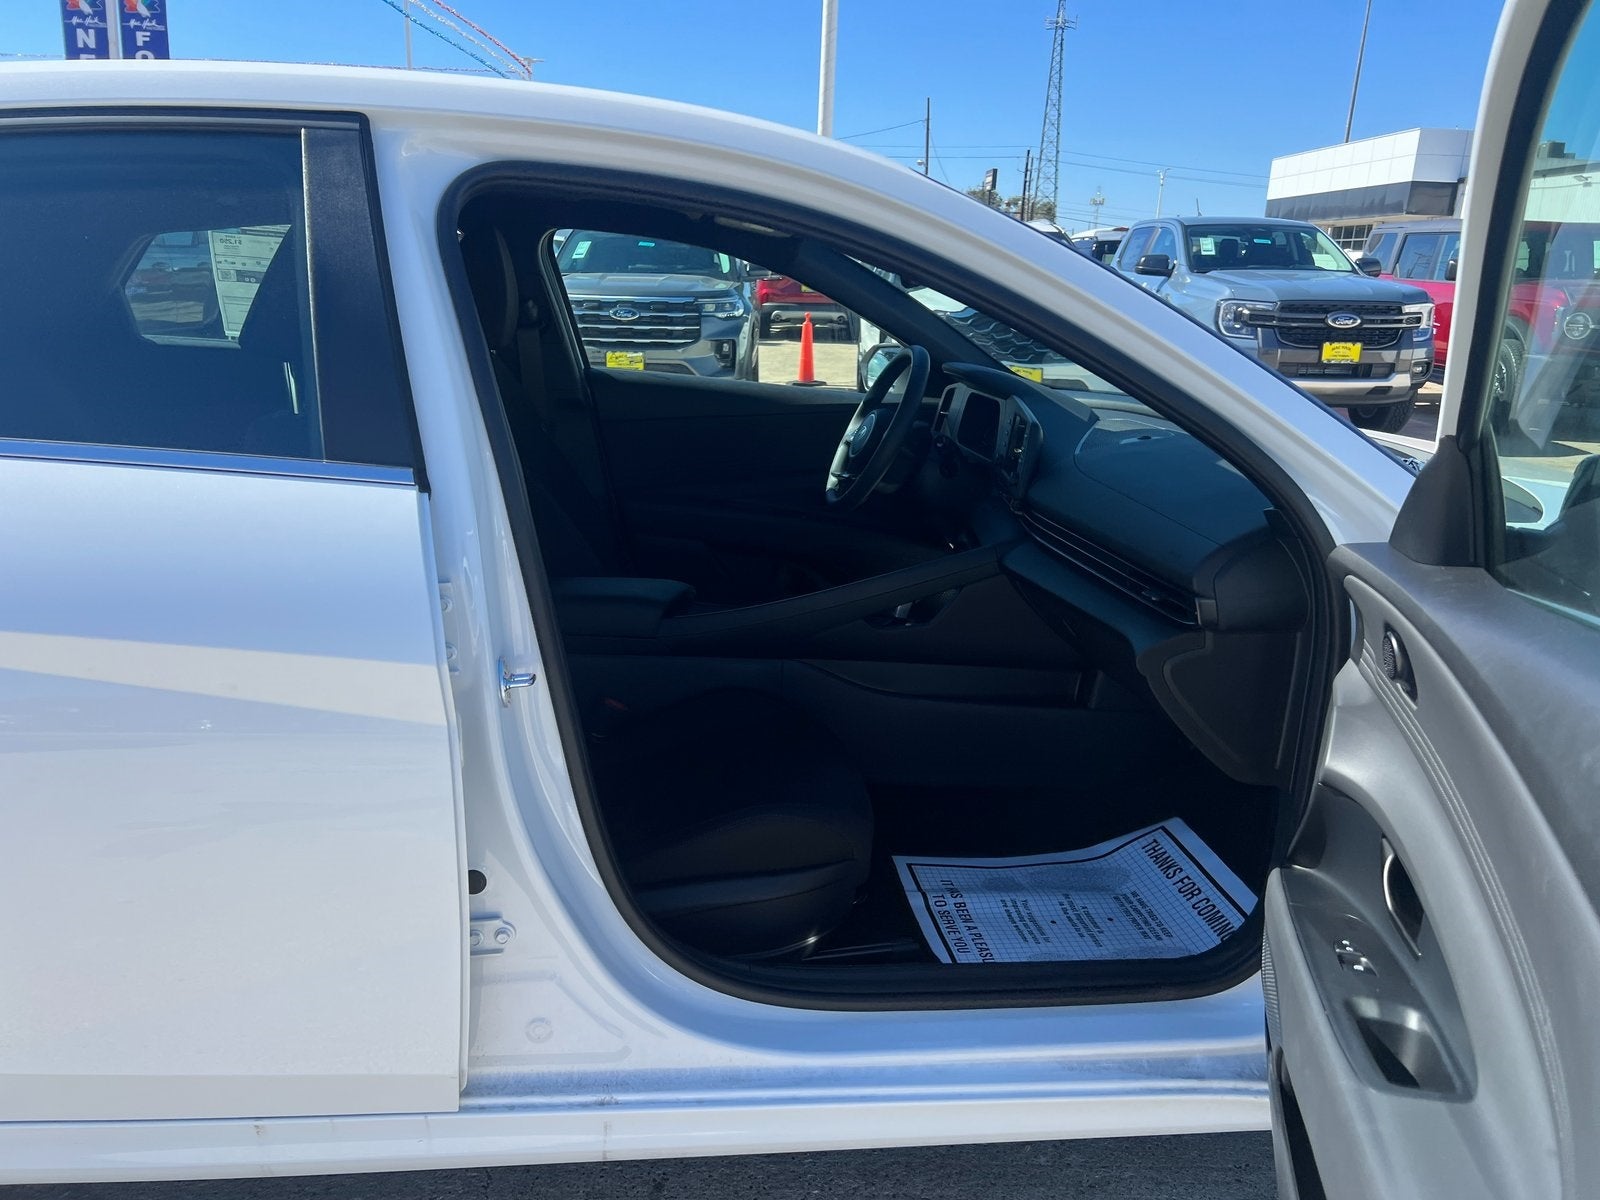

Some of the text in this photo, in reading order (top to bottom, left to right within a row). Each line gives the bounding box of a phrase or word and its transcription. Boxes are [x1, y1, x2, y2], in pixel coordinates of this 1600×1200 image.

[76, 28, 96, 60] N
[1142, 839, 1183, 880] THANKS
[1172, 875, 1202, 901] FOR
[932, 894, 971, 954] TO SERVE YOU
[954, 901, 974, 923] BEEN
